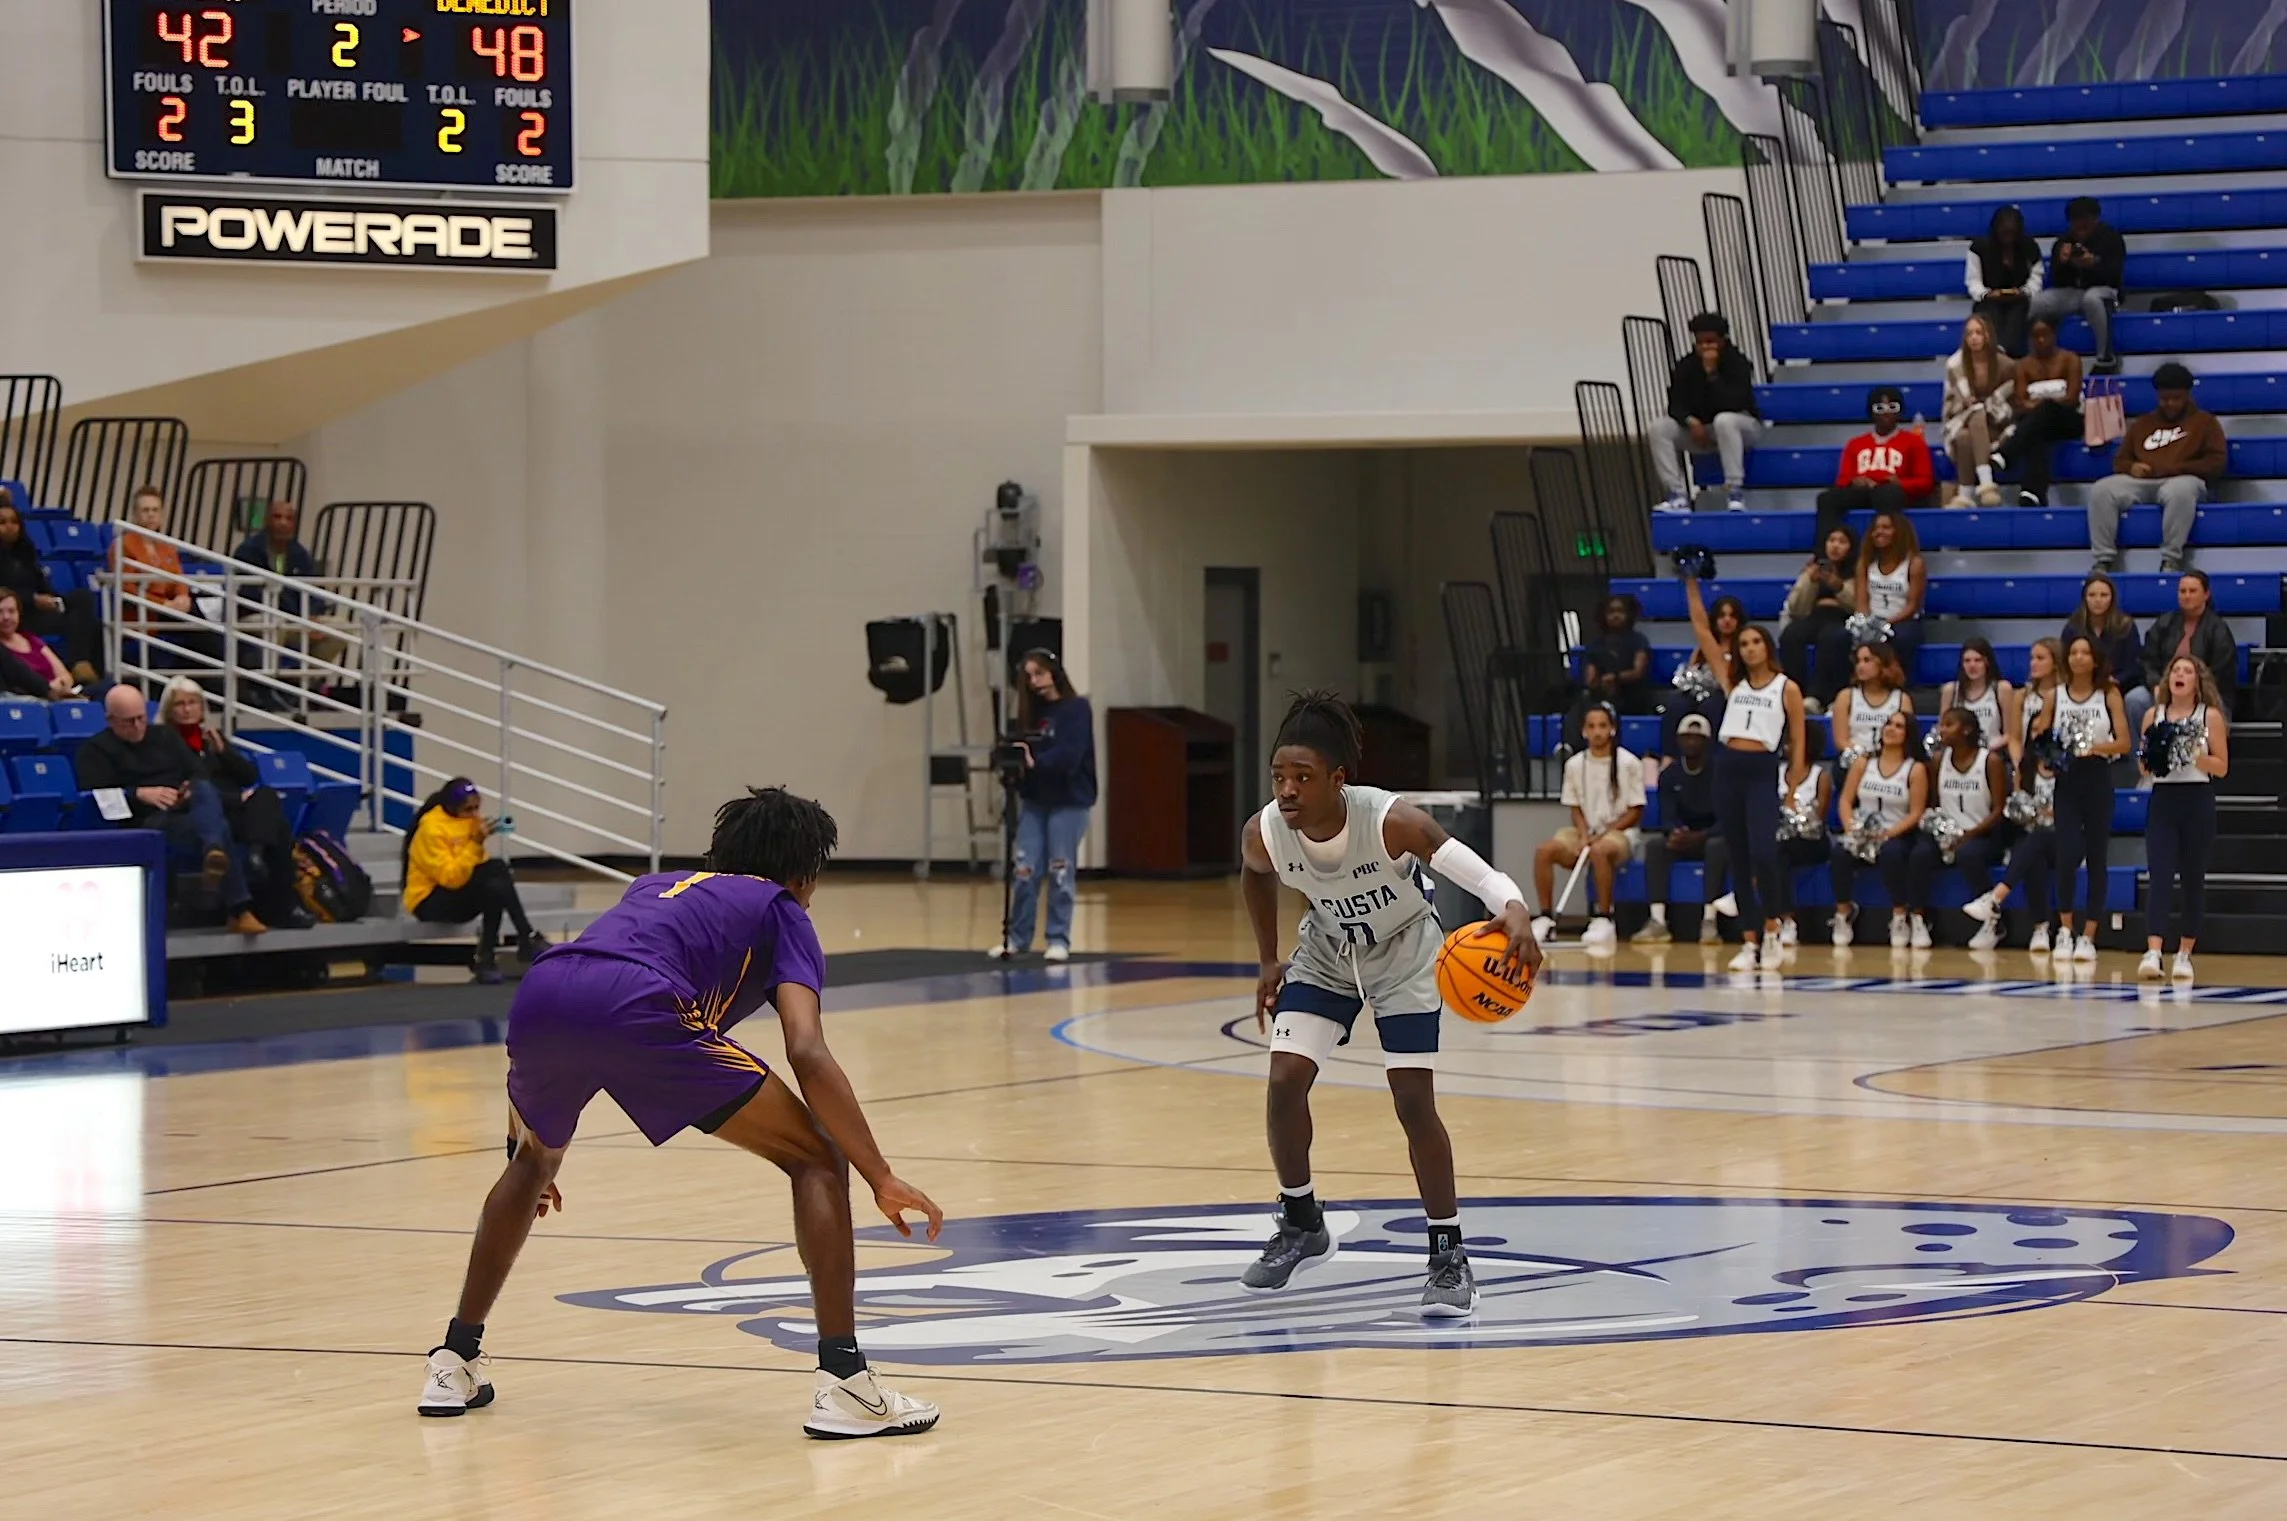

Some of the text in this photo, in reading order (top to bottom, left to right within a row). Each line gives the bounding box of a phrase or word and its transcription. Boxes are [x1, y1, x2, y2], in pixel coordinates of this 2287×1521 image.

[158, 11, 232, 68] 42
[332, 22, 359, 68] 2
[472, 25, 544, 82] 48
[133, 71, 194, 94] FOULS
[214, 75, 267, 97] T.O.L.
[287, 78, 409, 103] PLAYER FOUL
[426, 84, 477, 105] T.O.L.
[494, 87, 553, 109] FOULS
[158, 97, 187, 142] 2
[229, 99, 255, 145] 3
[437, 108, 466, 153] 2
[516, 112, 546, 156] 2
[135, 150, 195, 172] SCORE
[316, 157, 380, 179] MATCH
[495, 164, 553, 184] SCORE
[161, 205, 534, 260] POWERADE
[1857, 446, 1903, 475] GAP
[1352, 861, 1380, 879] PBC
[1320, 884, 1397, 919] GUSTA
[50, 952, 104, 974] iHeart
[1472, 991, 1514, 1017] NCAA
